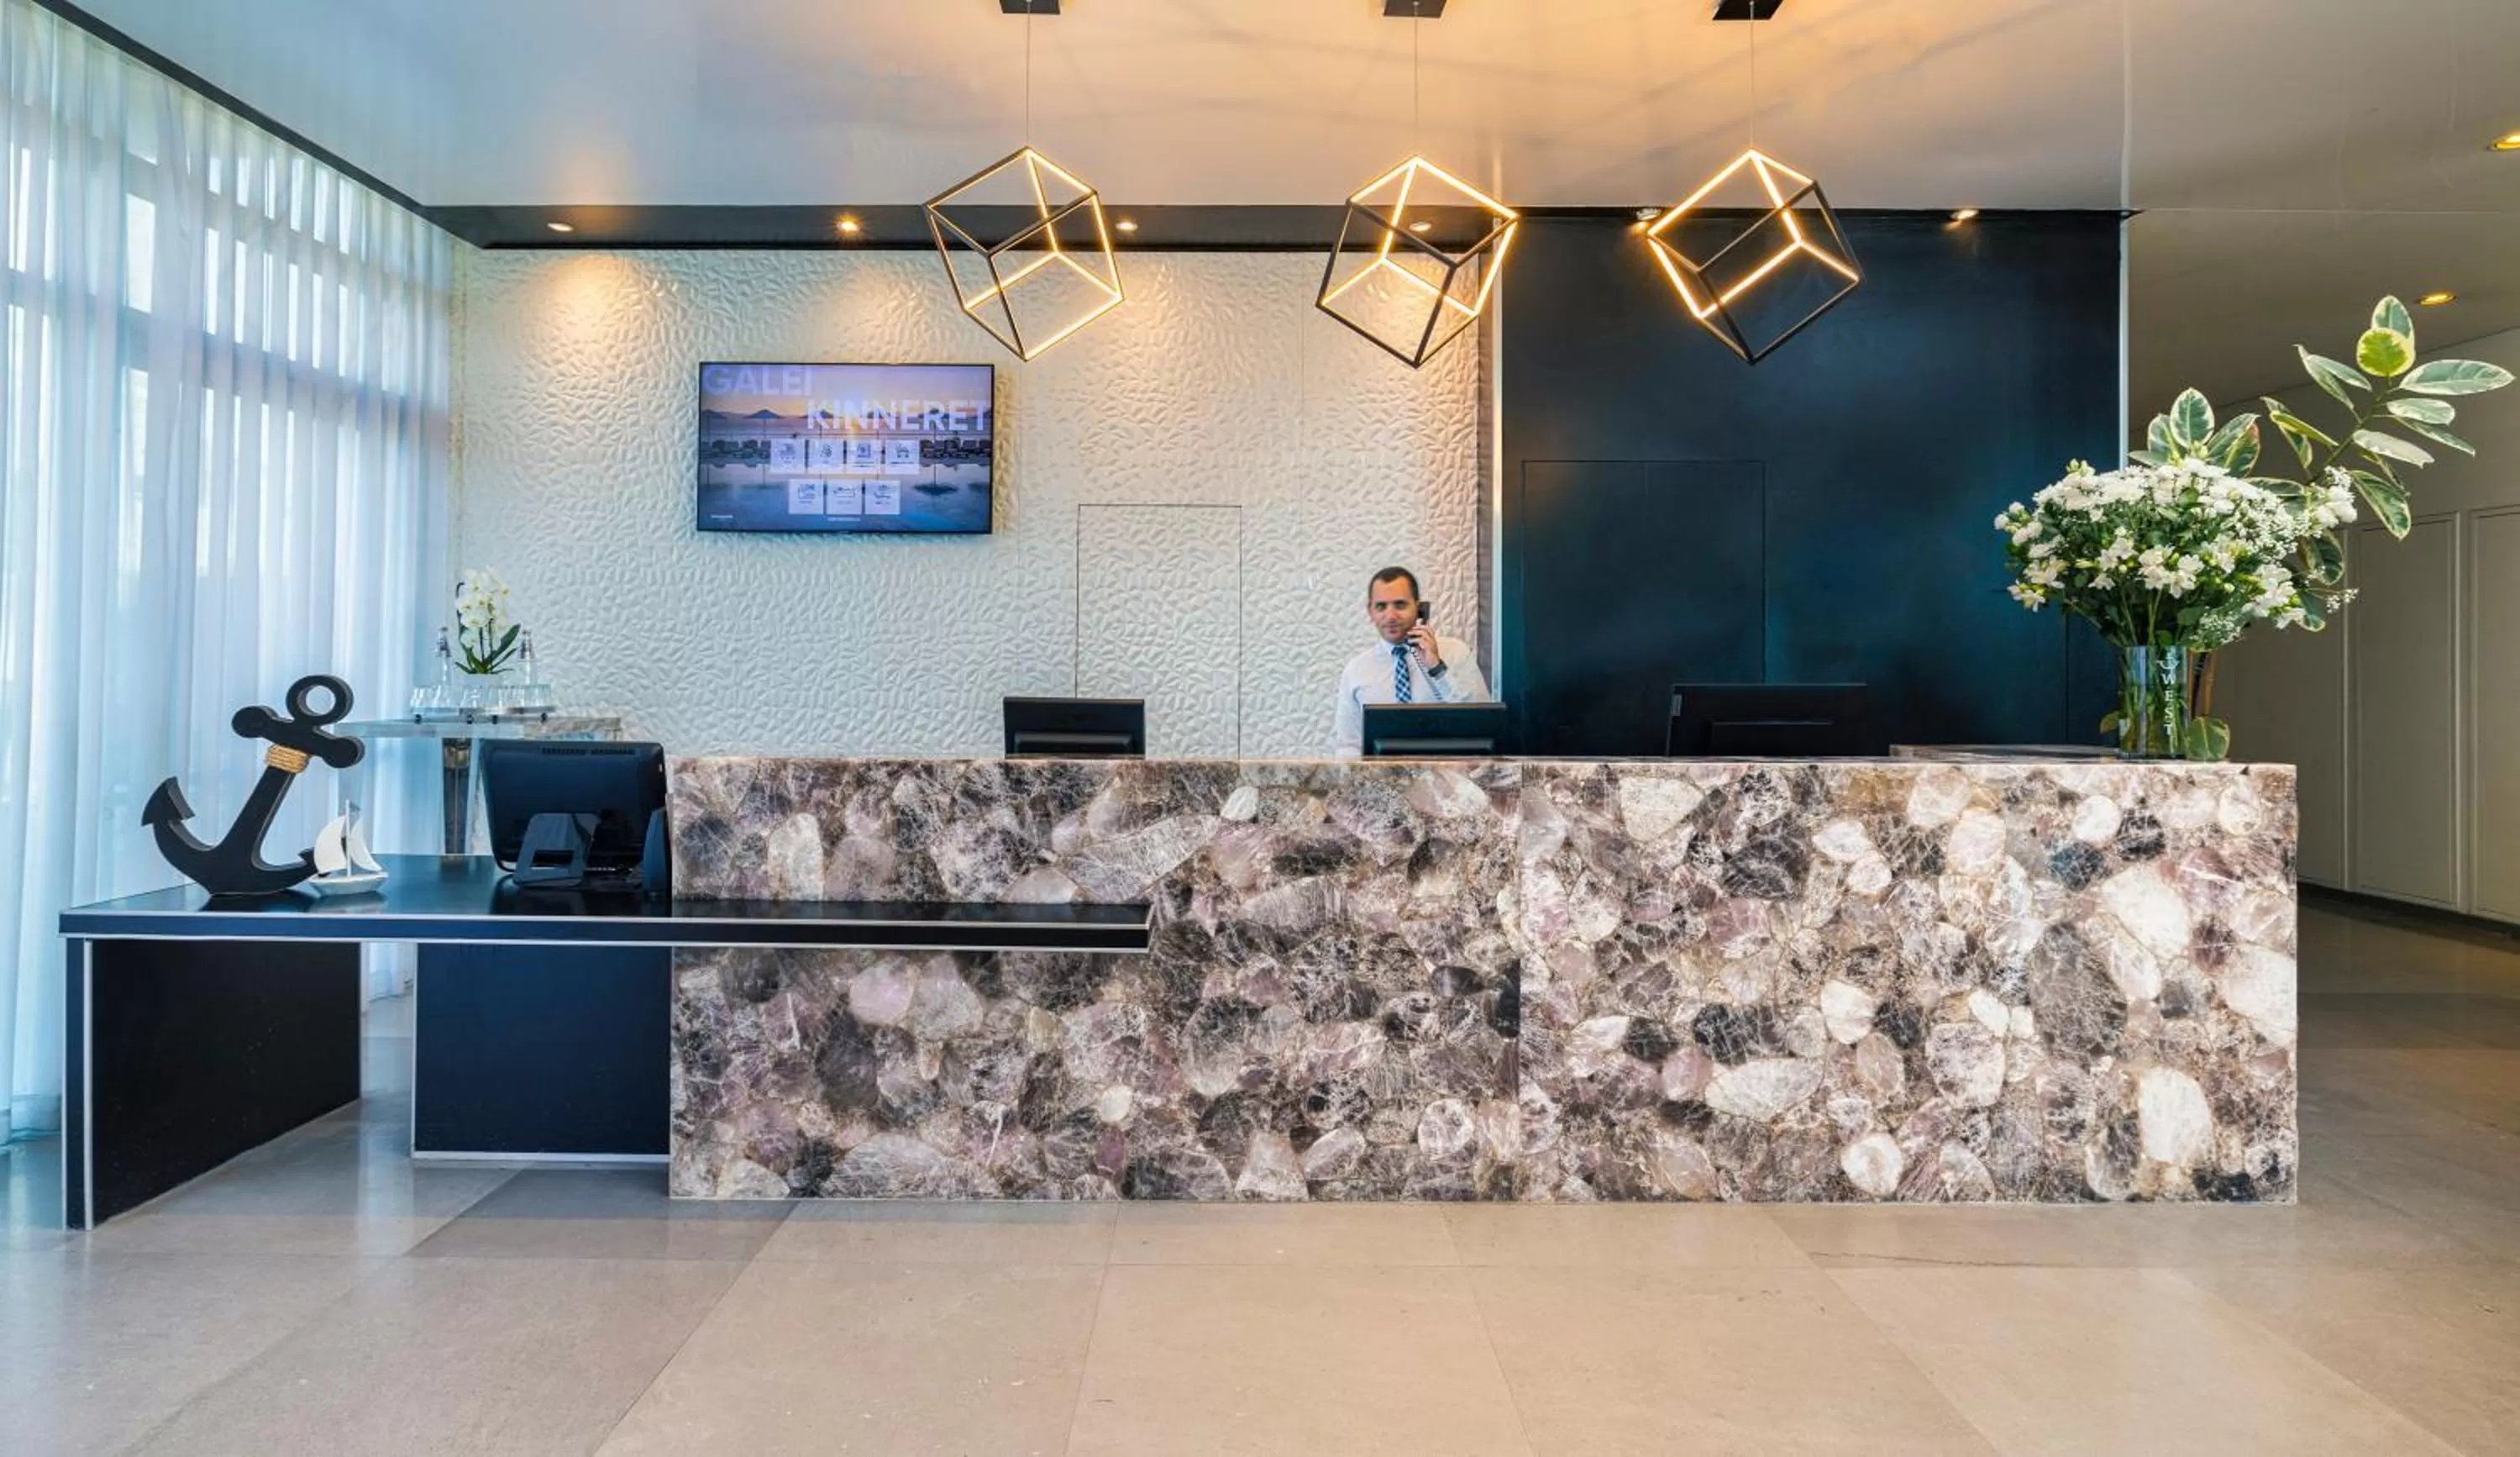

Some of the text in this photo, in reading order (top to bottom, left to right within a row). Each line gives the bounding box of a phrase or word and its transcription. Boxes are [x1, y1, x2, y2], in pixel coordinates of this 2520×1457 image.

[705, 366, 813, 395] GALEI
[807, 399, 988, 430] KINNERET
[2161, 673, 2176, 736] WEST
